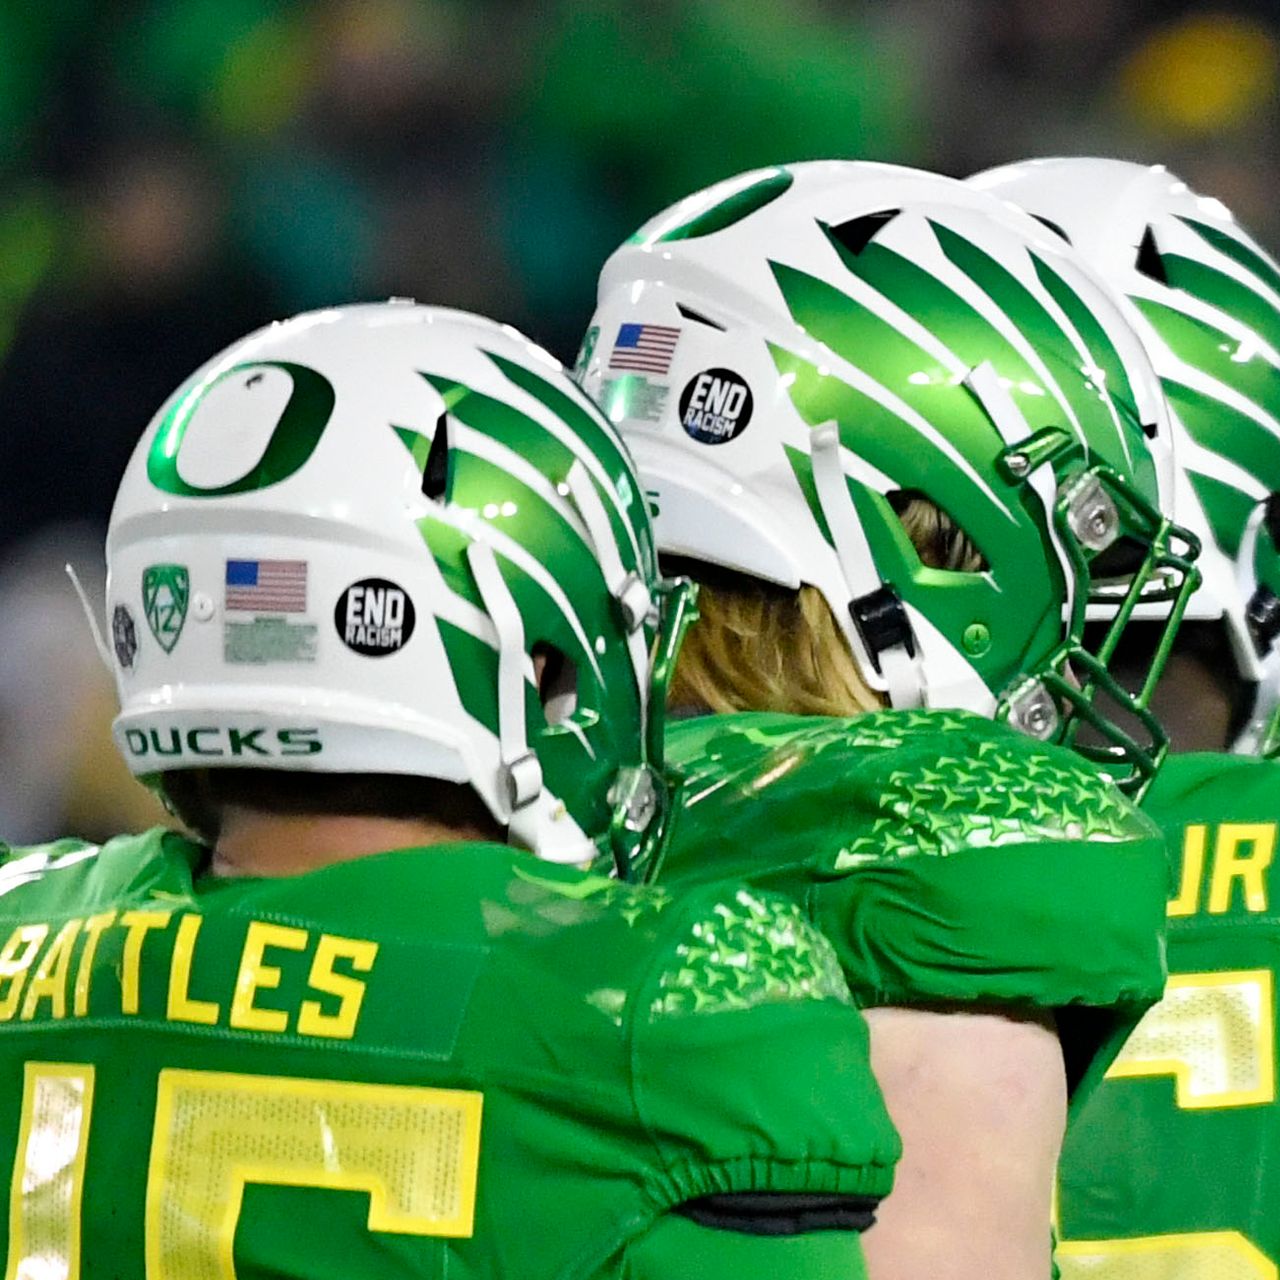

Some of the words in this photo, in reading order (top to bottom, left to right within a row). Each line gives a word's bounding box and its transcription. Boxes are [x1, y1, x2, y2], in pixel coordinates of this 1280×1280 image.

[688, 373, 748, 421] END
[146, 361, 337, 497] O
[683, 407, 736, 438] RACISM
[154, 603, 181, 633] 12
[346, 585, 406, 629] END
[344, 624, 403, 649] RACISM
[124, 726, 323, 757] DUCKS
[1165, 822, 1277, 917] JR
